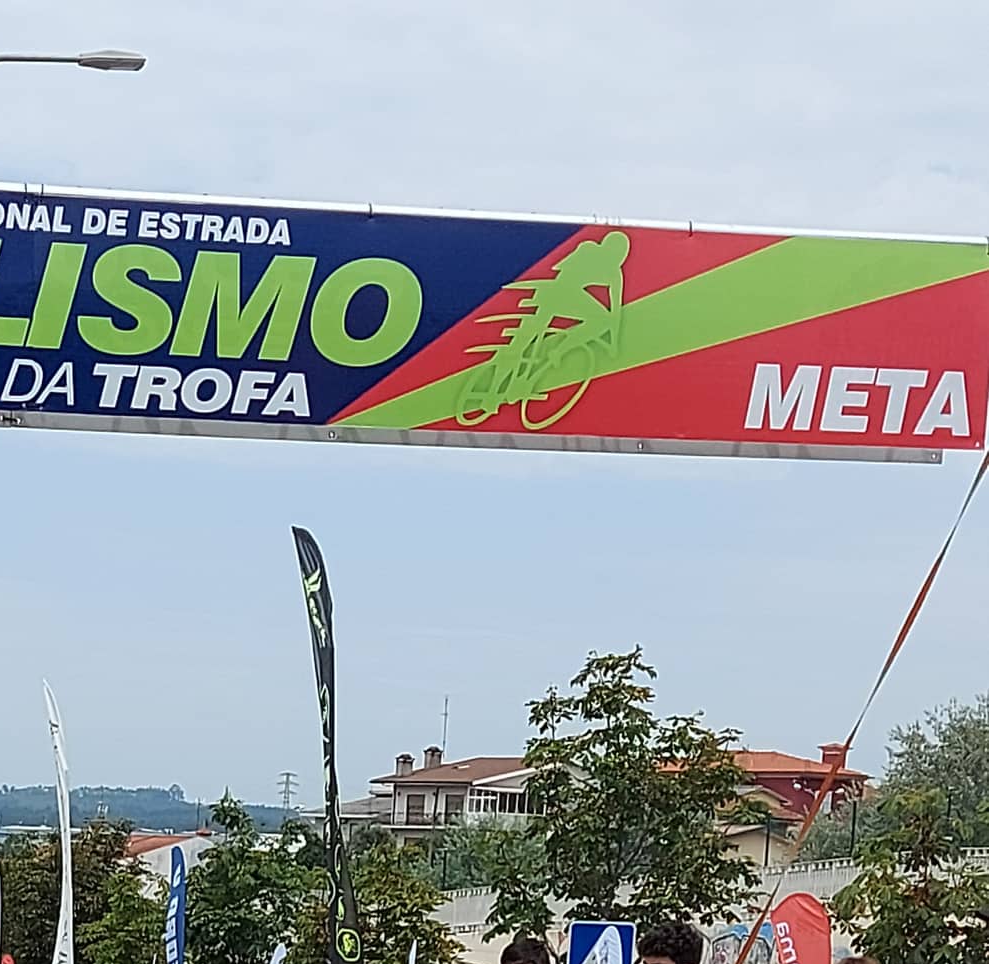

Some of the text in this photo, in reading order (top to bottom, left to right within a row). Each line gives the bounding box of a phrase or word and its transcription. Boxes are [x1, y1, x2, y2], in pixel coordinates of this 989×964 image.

[82, 207, 127, 236] DE
[138, 211, 291, 245] ESTRADA
[1, 358, 75, 405] DA
[93, 363, 311, 417] TROFA
[744, 363, 971, 436] META
